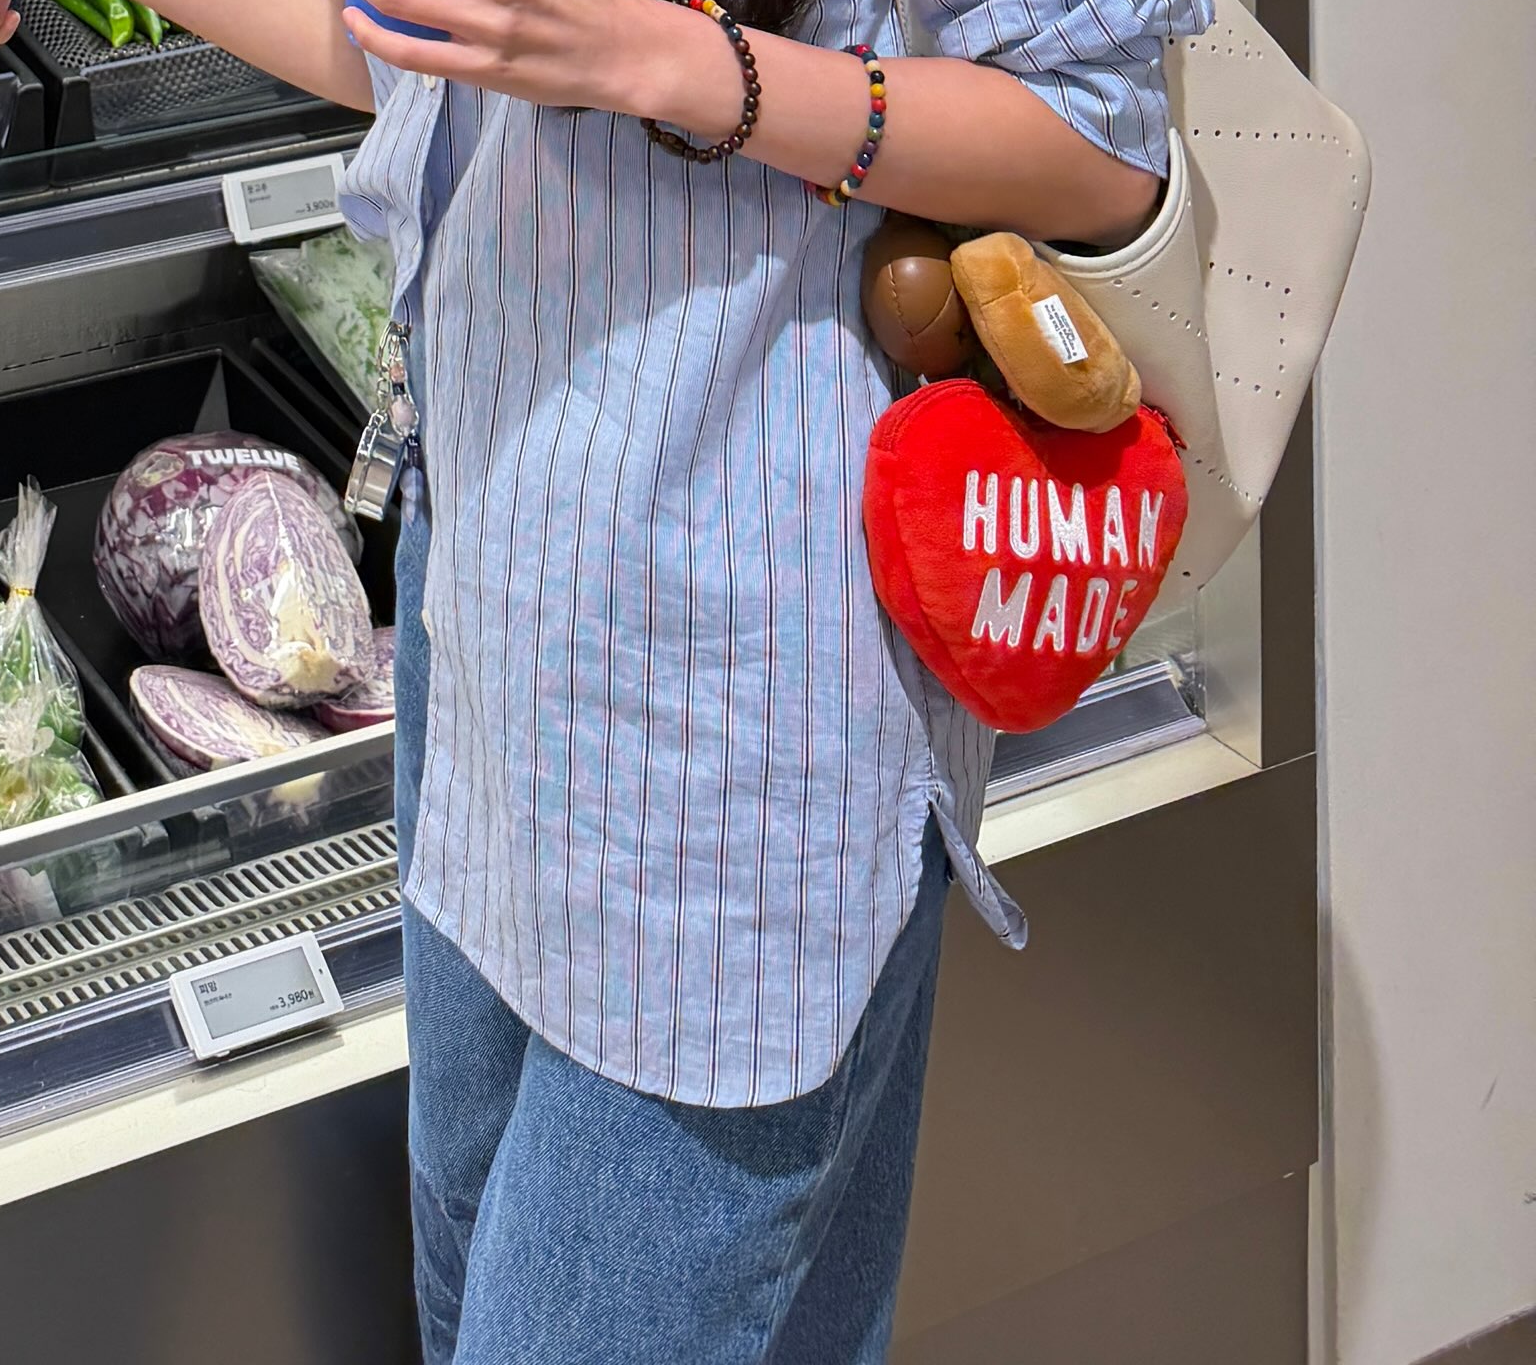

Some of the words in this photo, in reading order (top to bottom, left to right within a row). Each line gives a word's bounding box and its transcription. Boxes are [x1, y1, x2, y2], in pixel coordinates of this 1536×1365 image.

[186, 448, 302, 471] TWELVE
[963, 469, 1164, 567] HUMAN
[971, 568, 1138, 654] MADE
